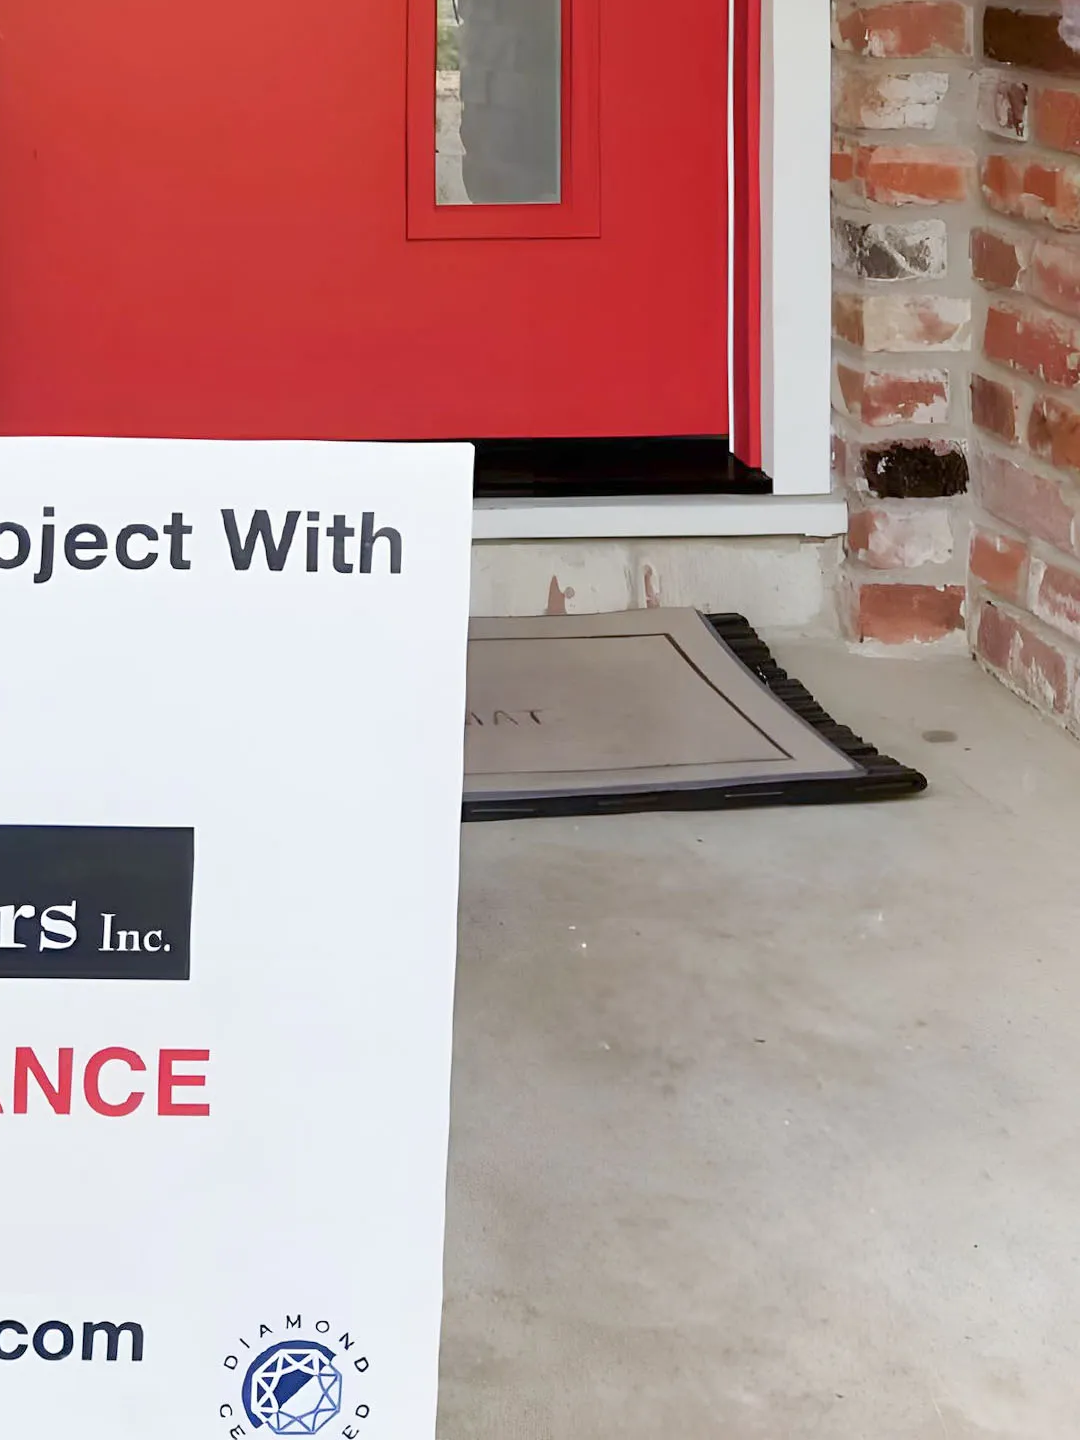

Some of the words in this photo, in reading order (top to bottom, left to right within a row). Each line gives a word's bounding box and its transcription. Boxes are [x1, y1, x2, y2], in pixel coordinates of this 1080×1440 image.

[220, 508, 403, 574] With
[98, 912, 172, 954] Inc.
[223, 1314, 371, 1373] DIAMOND
